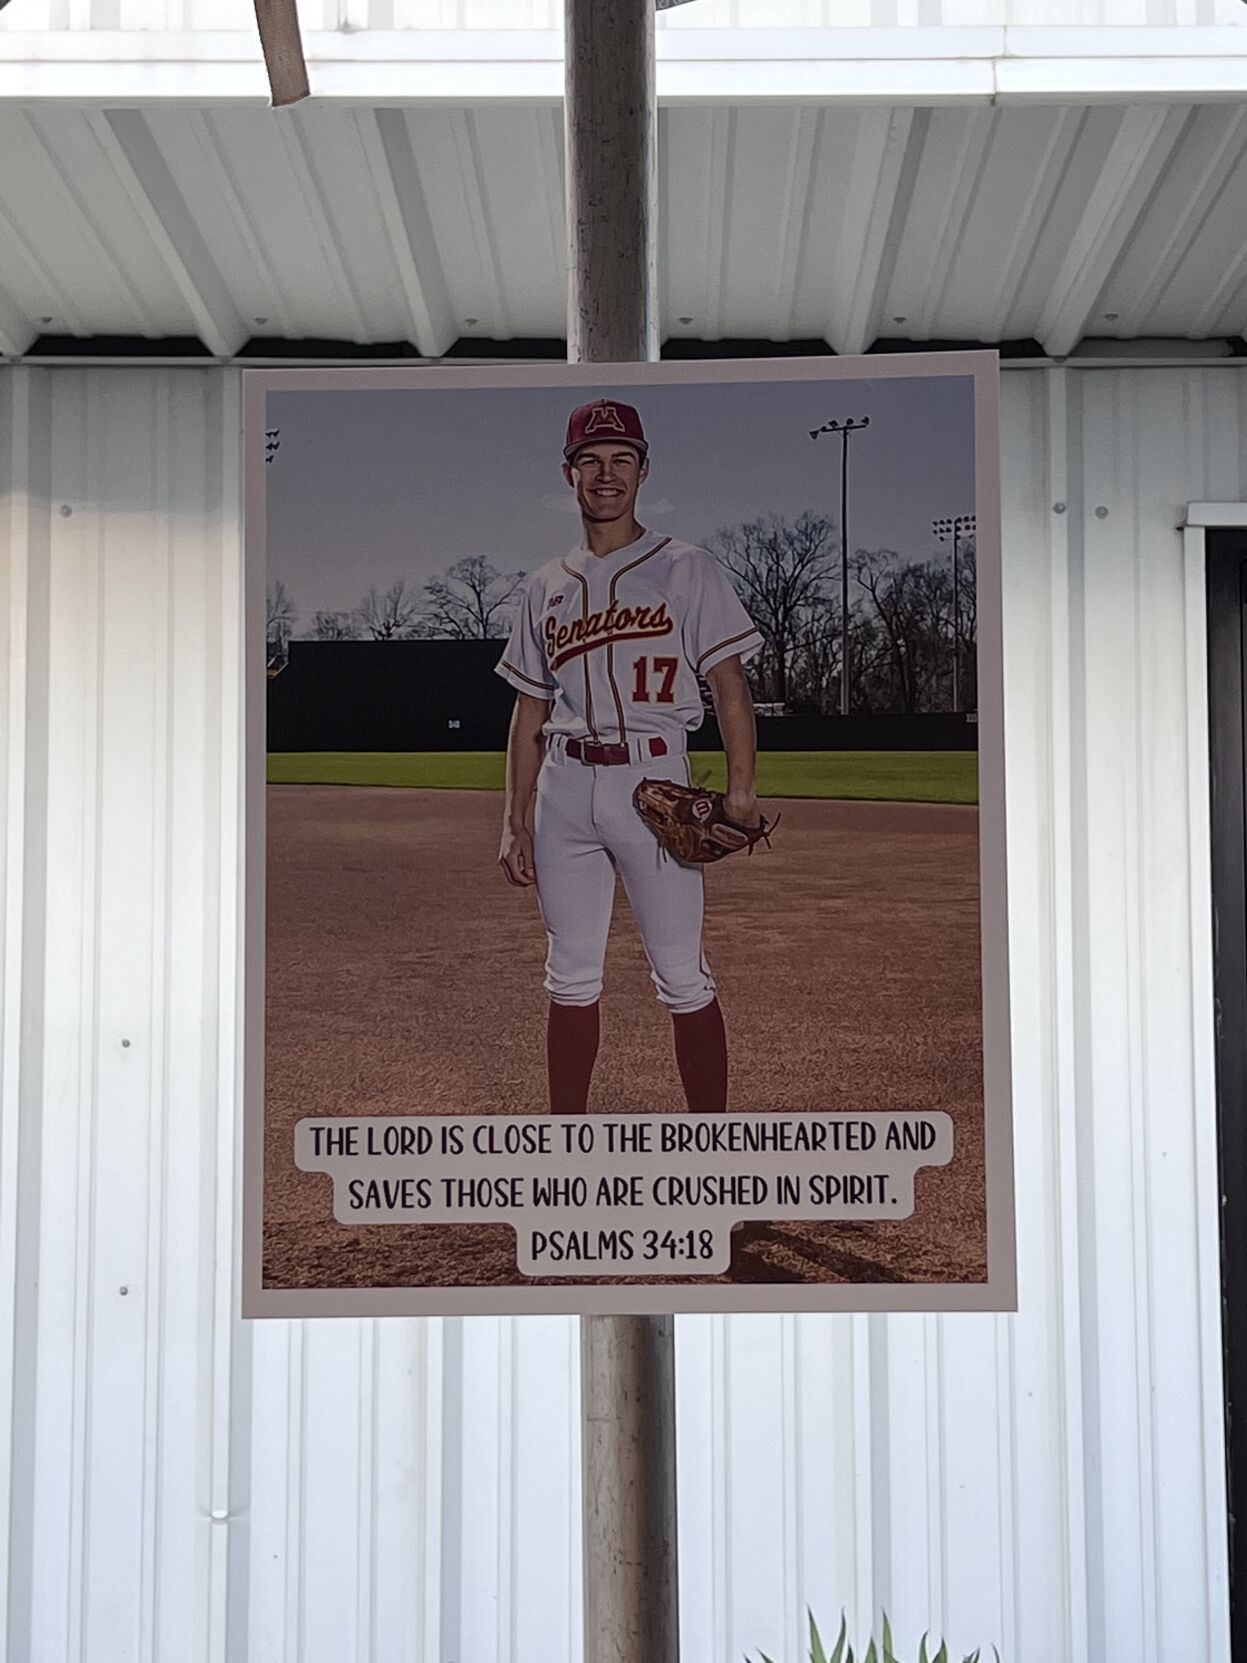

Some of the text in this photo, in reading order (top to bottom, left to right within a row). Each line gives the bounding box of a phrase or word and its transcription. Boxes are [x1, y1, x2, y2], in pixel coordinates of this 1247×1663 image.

[545, 600, 673, 658] Senators
[631, 655, 679, 704] 17
[309, 1120, 937, 1157] THE LORD IS CLOSE TO THE BROKENHEARTED AND
[348, 1174, 898, 1210] SAVES THOSE WHO ARE CRUSHED IN SPIRIT.
[531, 1229, 714, 1261] PSALMS 34:18
